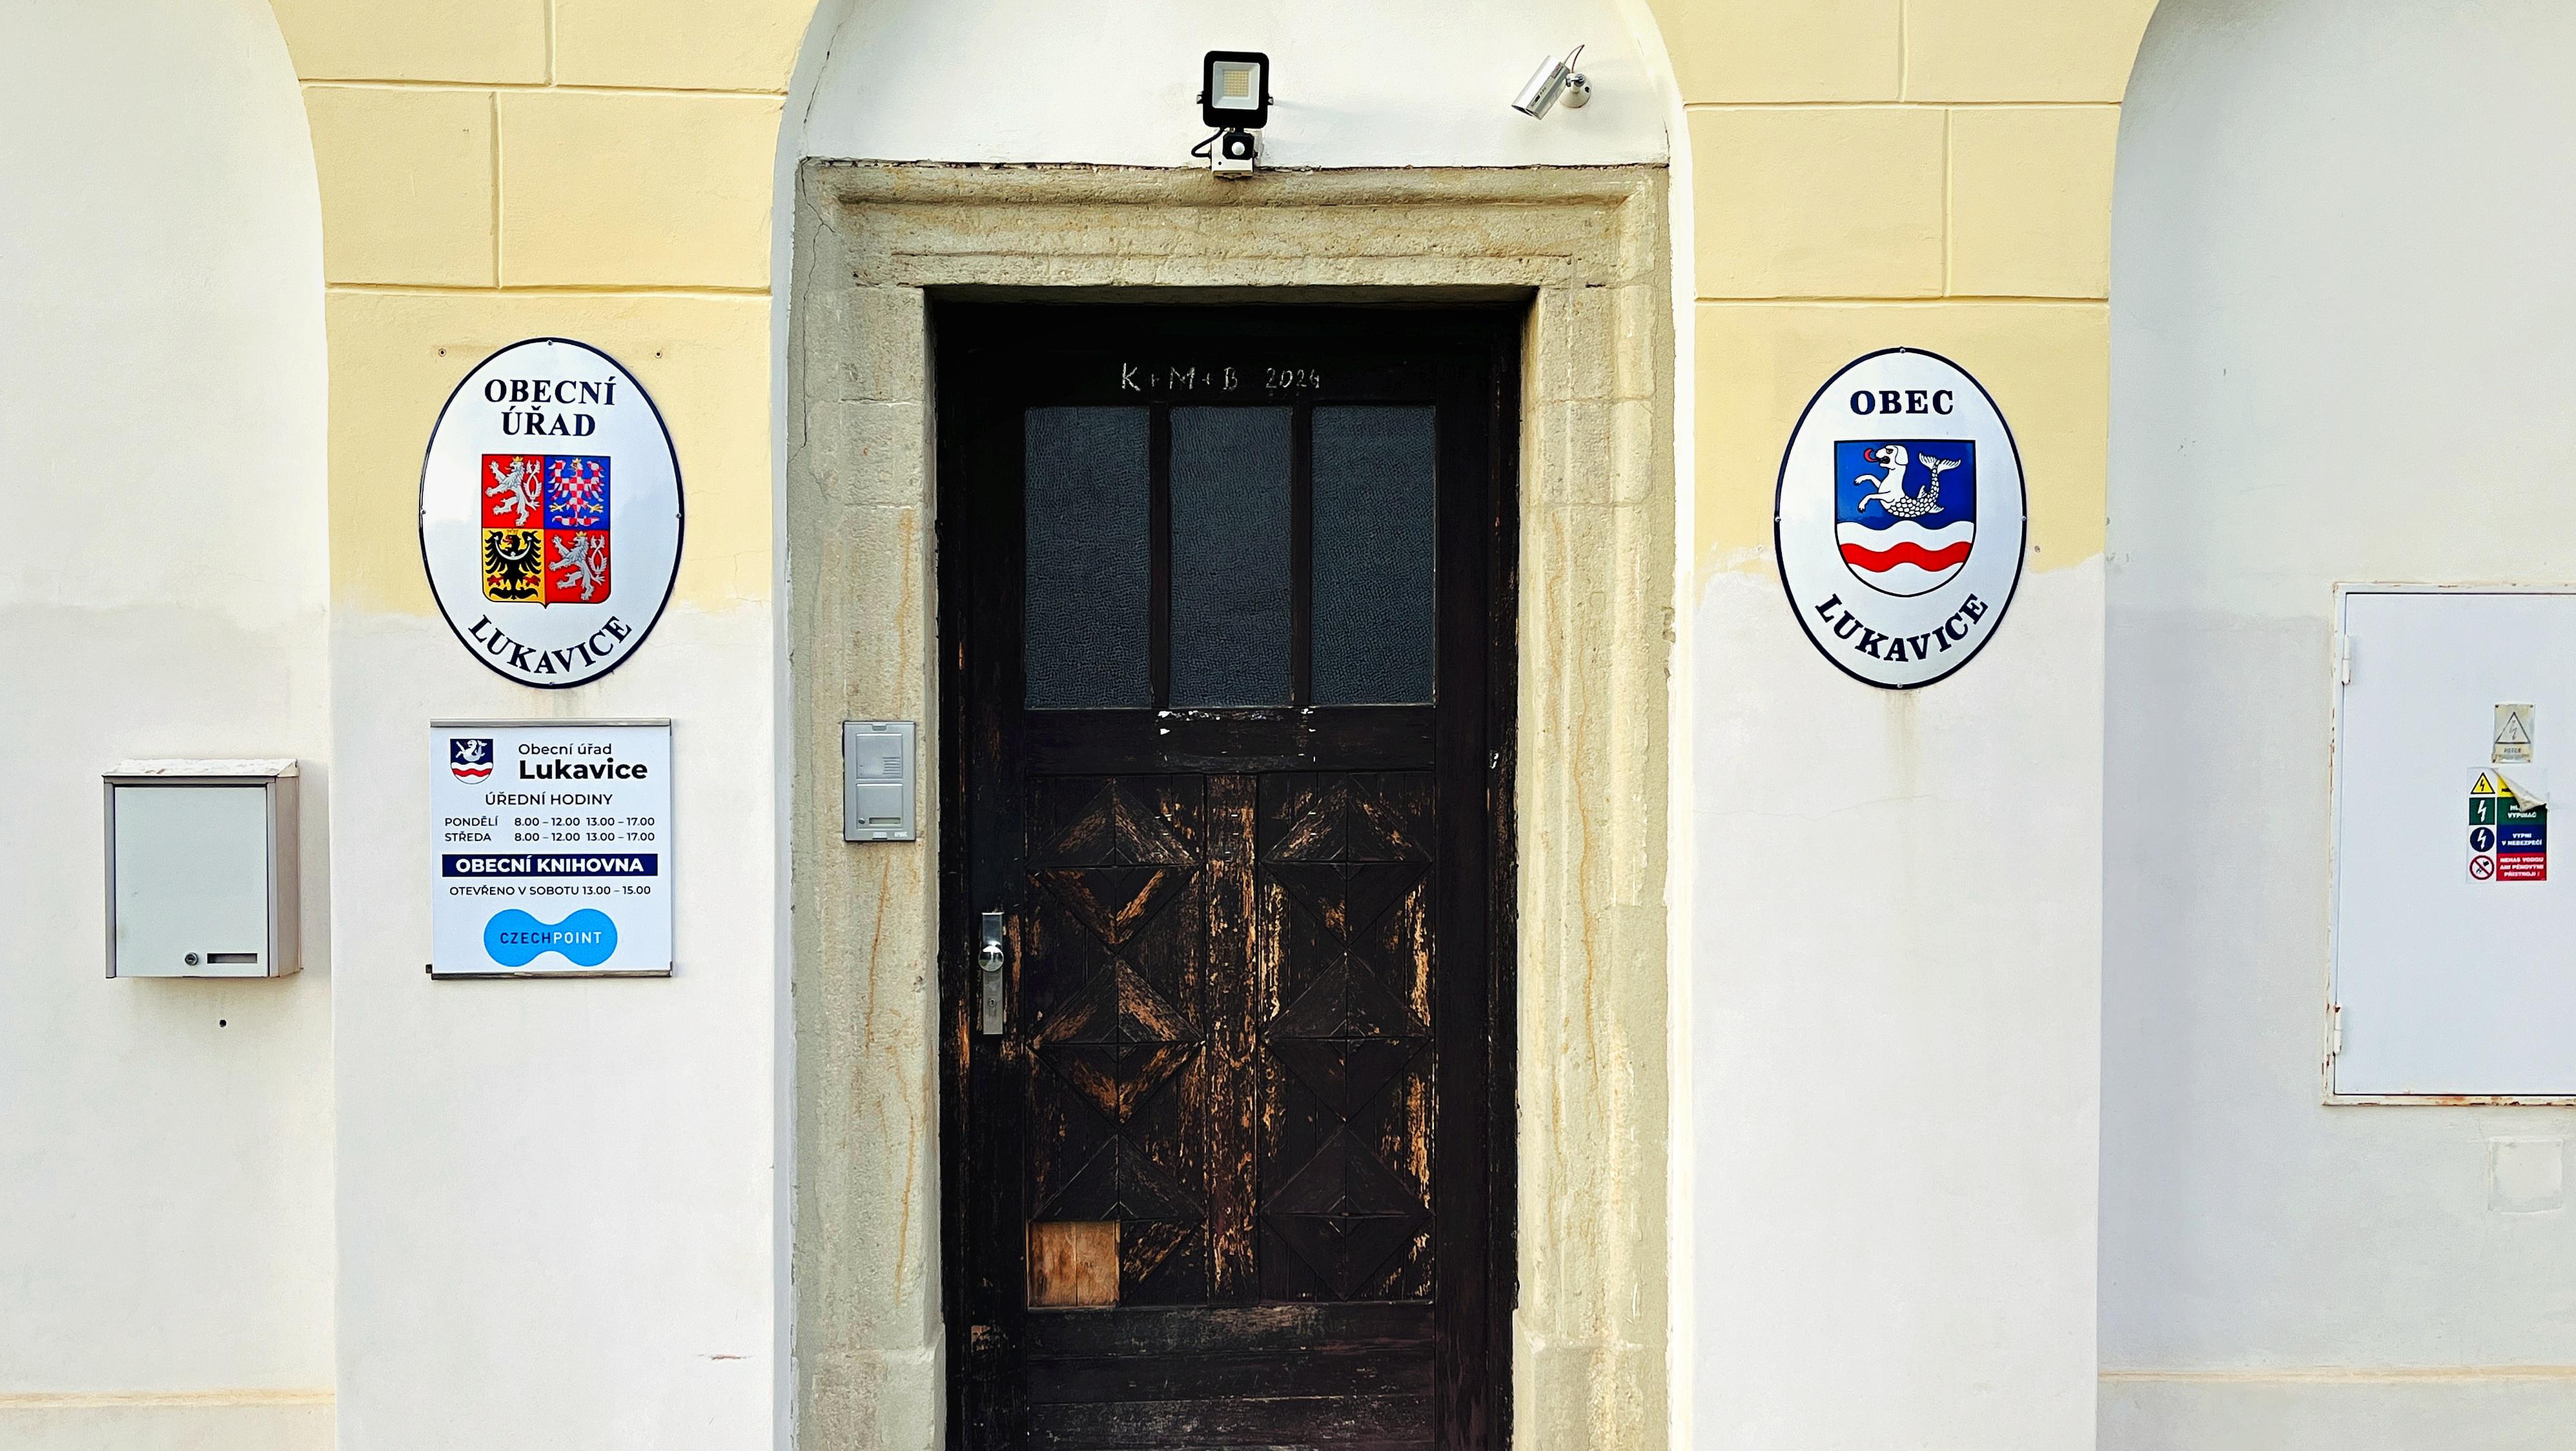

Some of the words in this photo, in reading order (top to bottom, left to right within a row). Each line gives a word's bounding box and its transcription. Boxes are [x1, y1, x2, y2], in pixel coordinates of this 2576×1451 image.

[1265, 367, 1320, 389] 2024
[484, 376, 617, 406] OBECNÍ
[1850, 389, 1954, 415] OBEC
[501, 405, 596, 437] ÚŘAD
[1814, 593, 1988, 662] LUKAVICE
[467, 614, 633, 675] LUKAVICE
[518, 743, 574, 755] Obecní
[578, 743, 612, 755] úřad
[519, 757, 648, 780] Lukavice
[486, 791, 546, 806] ÚŘEDNÍ
[551, 794, 613, 806] HODINY
[445, 815, 498, 827] PONDĚLÍ
[514, 817, 540, 827] 8.00
[551, 817, 580, 827] 12.00
[586, 817, 615, 826] 13.00
[626, 817, 655, 826] 17.00
[444, 830, 492, 842] STŘEDA
[514, 833, 540, 842] 8.00
[551, 833, 580, 842] 12.00
[586, 832, 615, 841] 13.00
[626, 832, 655, 841] 17.00
[455, 855, 533, 873] OBECNÍ
[537, 858, 644, 873] KNIHOVNA
[449, 884, 515, 895] OTEVŘENO
[518, 886, 527, 895] V
[529, 886, 579, 895] SOBOTU
[582, 886, 611, 895] 13.00
[622, 886, 651, 895] 15.00
